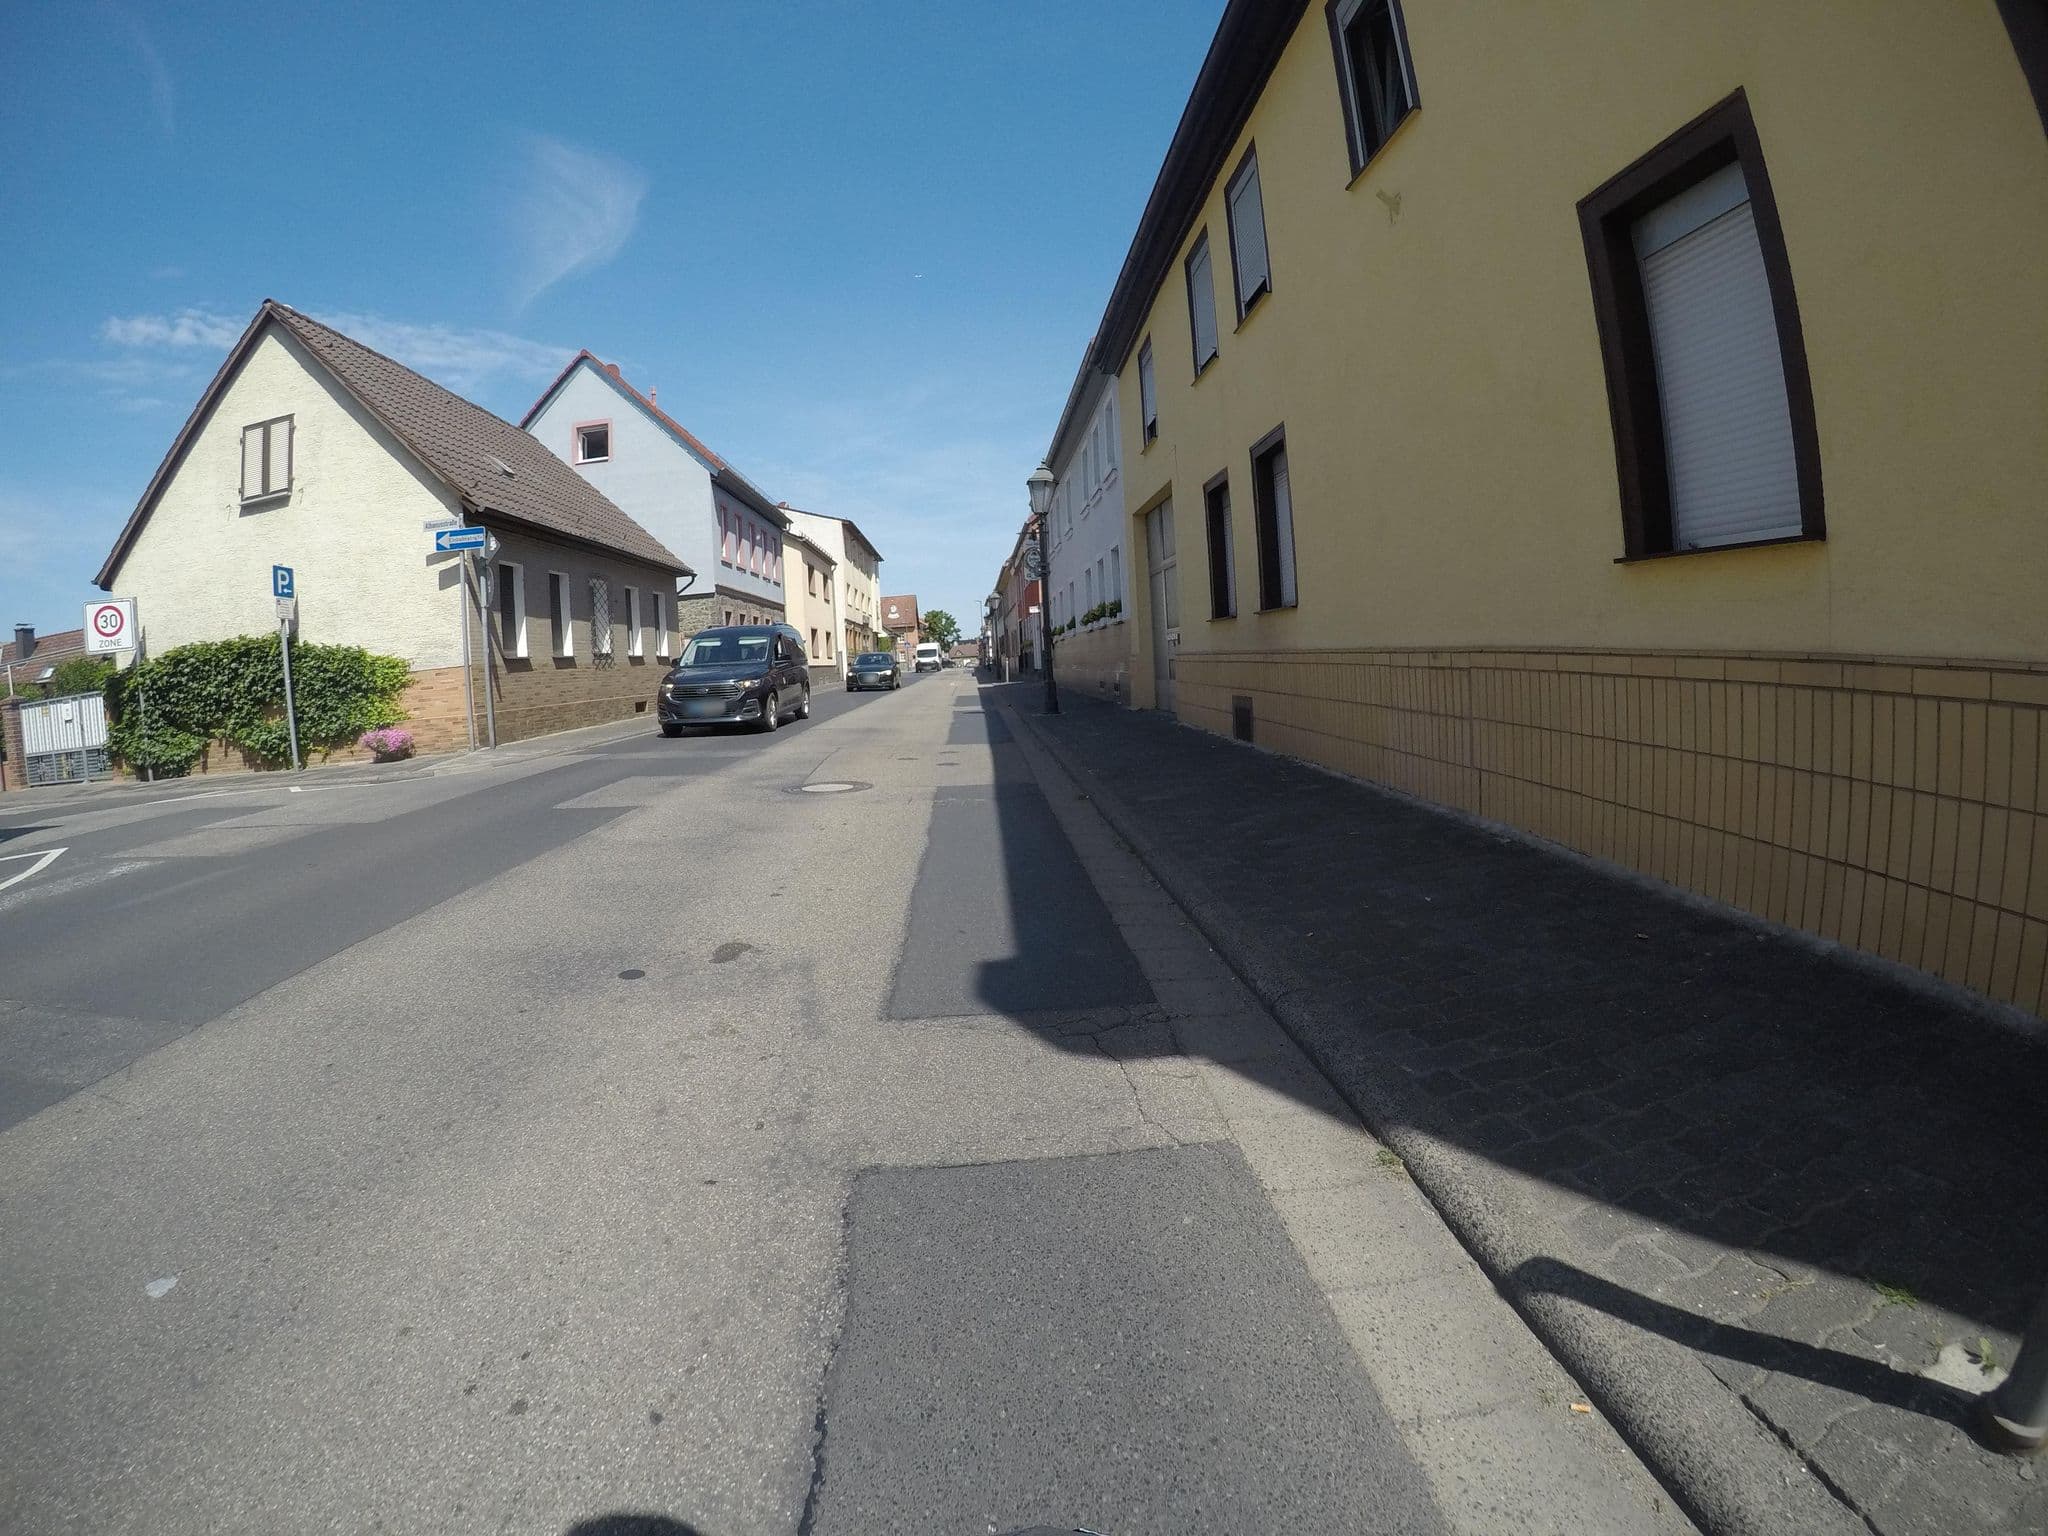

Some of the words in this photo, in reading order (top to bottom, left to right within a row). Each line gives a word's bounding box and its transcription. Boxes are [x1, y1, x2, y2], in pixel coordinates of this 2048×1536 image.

[277, 569, 289, 594] P
[100, 614, 118, 629] 30
[98, 638, 122, 649] ZONE
